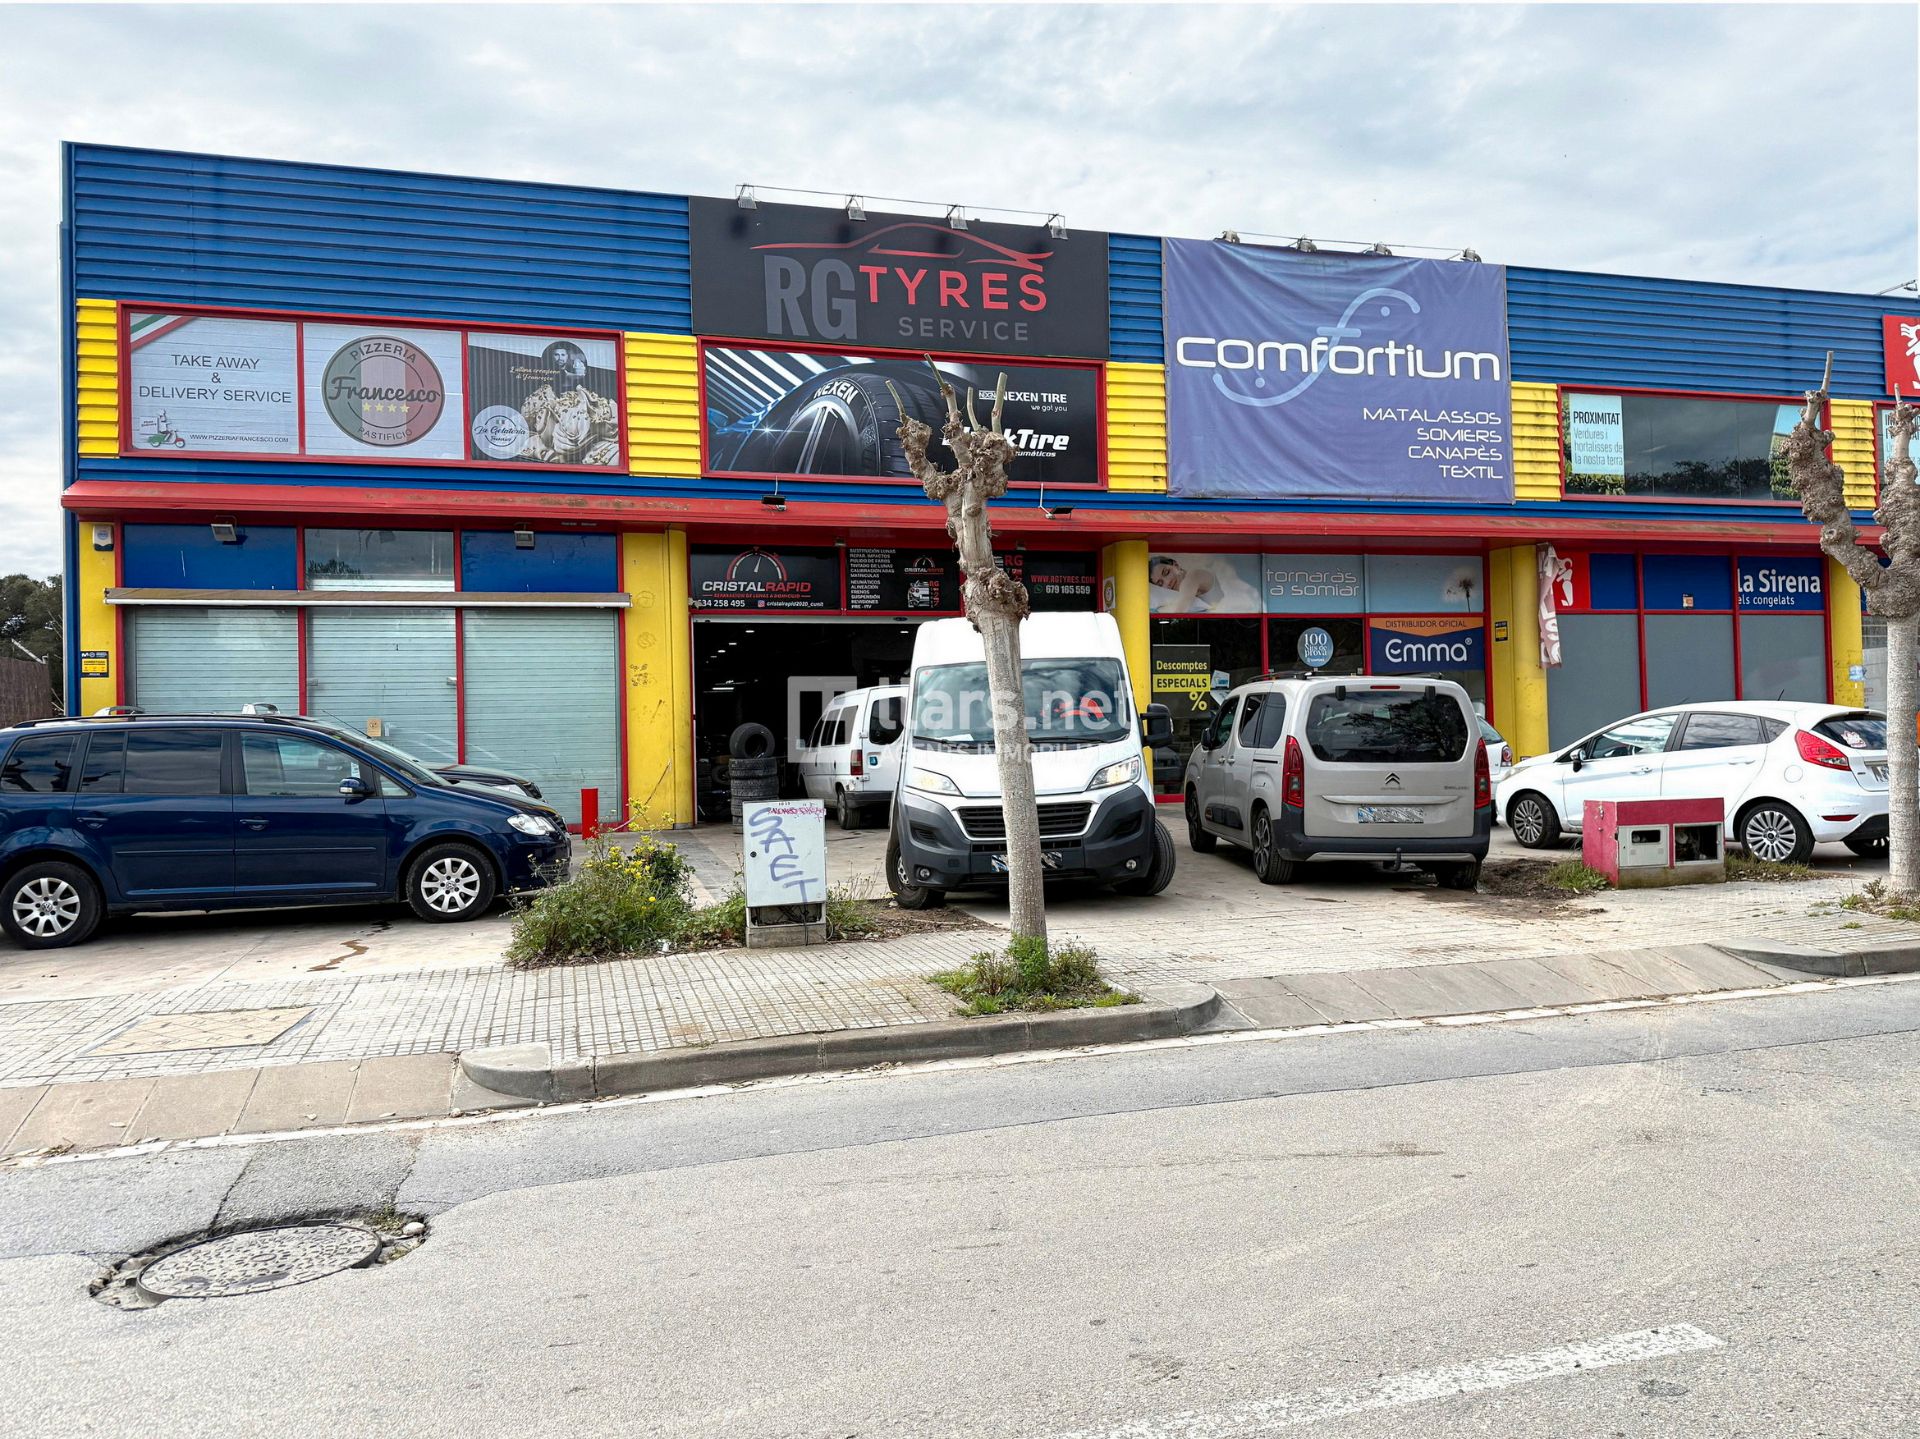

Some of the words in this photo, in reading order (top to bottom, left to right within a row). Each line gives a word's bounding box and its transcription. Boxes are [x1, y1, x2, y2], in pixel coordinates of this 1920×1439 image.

[763, 254, 858, 340] RG
[859, 264, 1047, 313] TYRES
[898, 316, 1029, 341] SERVICE
[350, 342, 417, 363] PIZZERIA
[1176, 336, 1501, 382] comfortium
[171, 354, 212, 368] TAKE
[215, 356, 260, 370] AWAY
[211, 372, 222, 384] &
[139, 385, 219, 401] DELIVERY
[223, 389, 292, 404] SERVICE
[328, 376, 440, 403] Francesco
[813, 381, 859, 406] NEXEN
[1001, 391, 1039, 403] NEXEN
[1041, 392, 1068, 404] TIRE
[1041, 404, 1054, 412] got
[1054, 404, 1068, 412] you
[1363, 407, 1502, 425] MATALASSOS
[1573, 411, 1620, 425] PROXIMITAT
[189, 434, 289, 443] WWW.PIZZERIAFRANCESCO.COM
[357, 427, 413, 441] PASTIFICIO
[1417, 427, 1502, 443] SOMIERS
[1574, 427, 1604, 440] Verdures
[1408, 445, 1503, 461] CANAPÈS
[1574, 440, 1613, 453] hortalisses
[1614, 442, 1623, 453] de
[1574, 453, 1582, 464] la
[1583, 454, 1606, 465] nostra
[1606, 455, 1624, 466] terra
[1439, 464, 1503, 479] TEXTIL
[1004, 555, 1024, 567] RG
[1030, 574, 1096, 584] WWW.RGTYRES.COM
[1265, 567, 1358, 584] tornaràs
[1758, 569, 1821, 593] Sirena
[702, 581, 812, 593] CRISTALRAPID
[1045, 585, 1060, 595] 679
[1061, 585, 1075, 595] 165
[1075, 585, 1091, 595] 559
[1270, 585, 1284, 596] a
[1291, 583, 1360, 597] somiar
[713, 599, 729, 608] 258
[730, 599, 746, 608] 495
[1753, 594, 1796, 608] congelats
[1385, 620, 1438, 628] DISTRIBUIDOR
[1439, 620, 1467, 628] OFICIAL
[1304, 633, 1328, 645] 100
[1156, 660, 1208, 673] Descomptes
[1157, 678, 1207, 688] ESPECIALS
[1189, 691, 1208, 711] %
